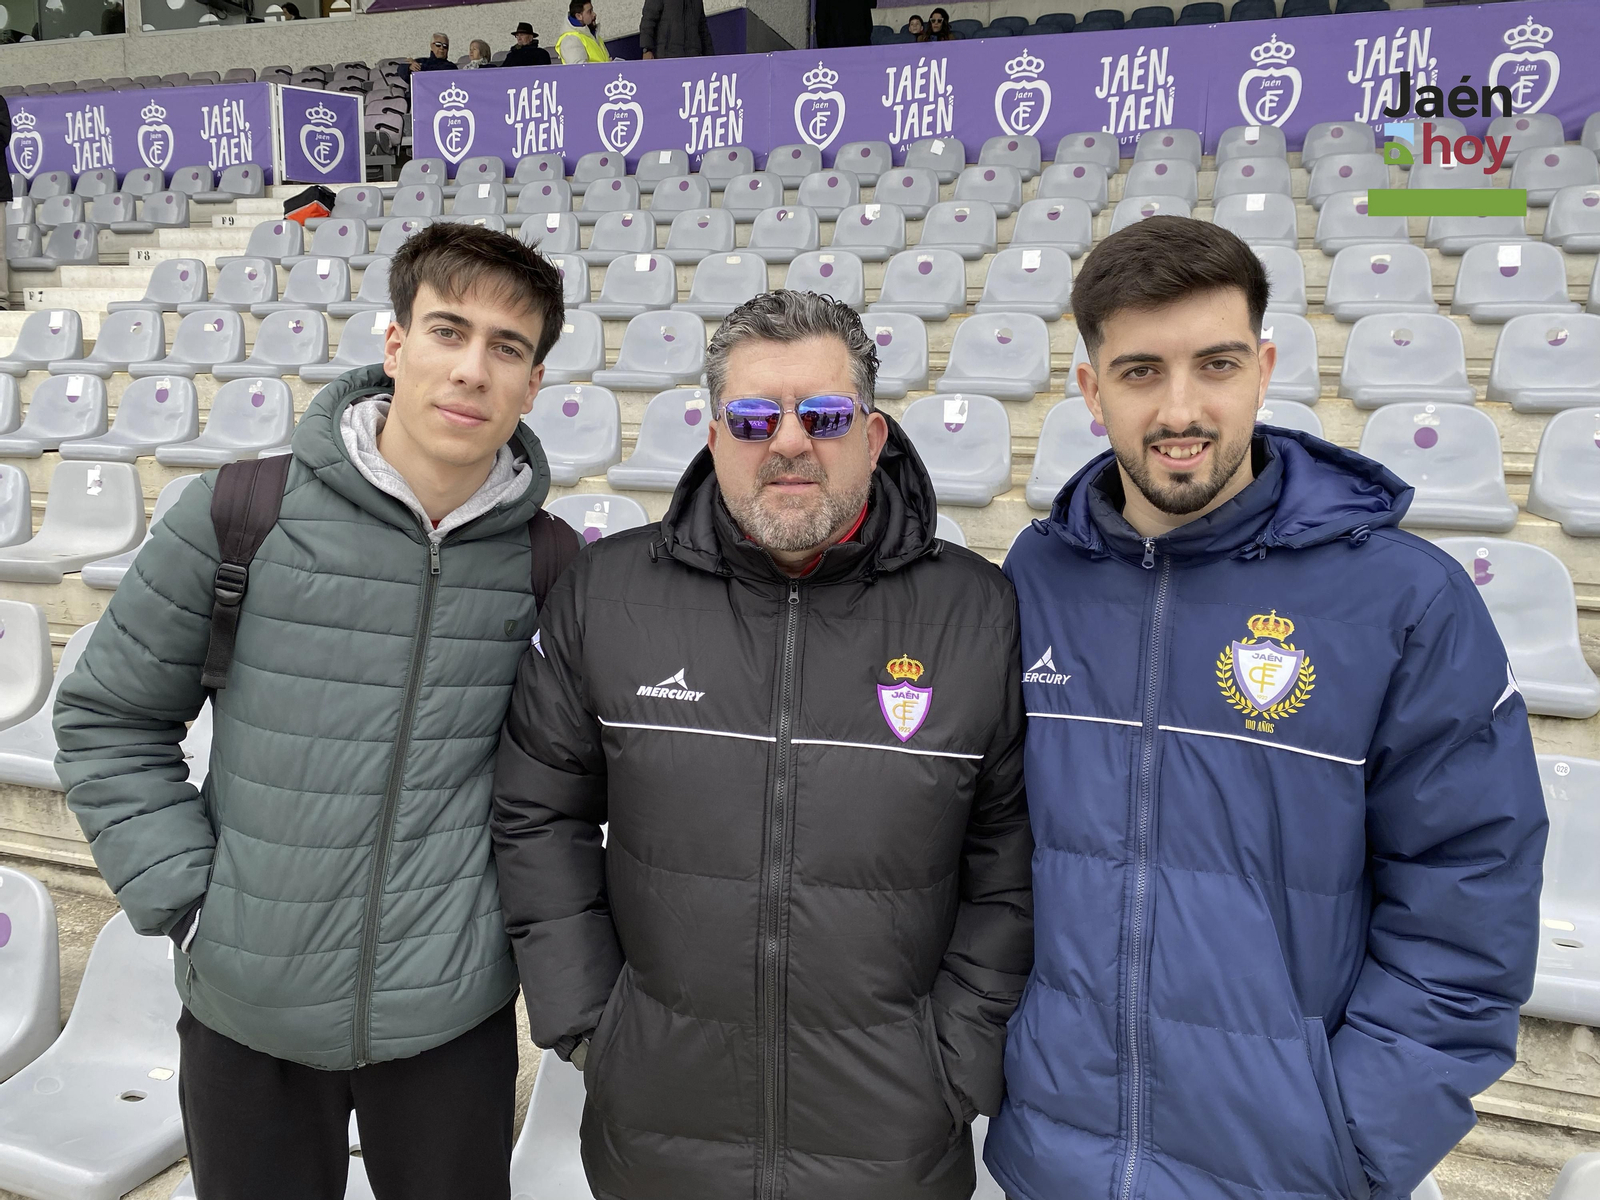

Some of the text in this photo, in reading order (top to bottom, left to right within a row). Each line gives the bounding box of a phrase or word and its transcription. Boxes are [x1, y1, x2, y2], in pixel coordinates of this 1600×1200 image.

[1095, 46, 1175, 99] JAÉN,
[1347, 26, 1438, 84] JAÉN,
[504, 79, 563, 125] JAÉN,
[679, 72, 743, 120] JAÉN,
[881, 57, 954, 107] JAÉN,
[64, 104, 111, 145] JAÉN,
[200, 98, 250, 140] JAÉN,
[685, 108, 743, 154] JAEN
[889, 95, 954, 145] JAEN
[1102, 87, 1175, 135] JAEN
[72, 136, 114, 174] JAEN
[208, 130, 252, 171] JAEN
[511, 115, 565, 159] JAEN
[1251, 652, 1283, 663] JAÉN
[636, 685, 706, 702] MERCURY
[891, 690, 920, 700] JAÉN
[1257, 720, 1275, 734] AÑOS
